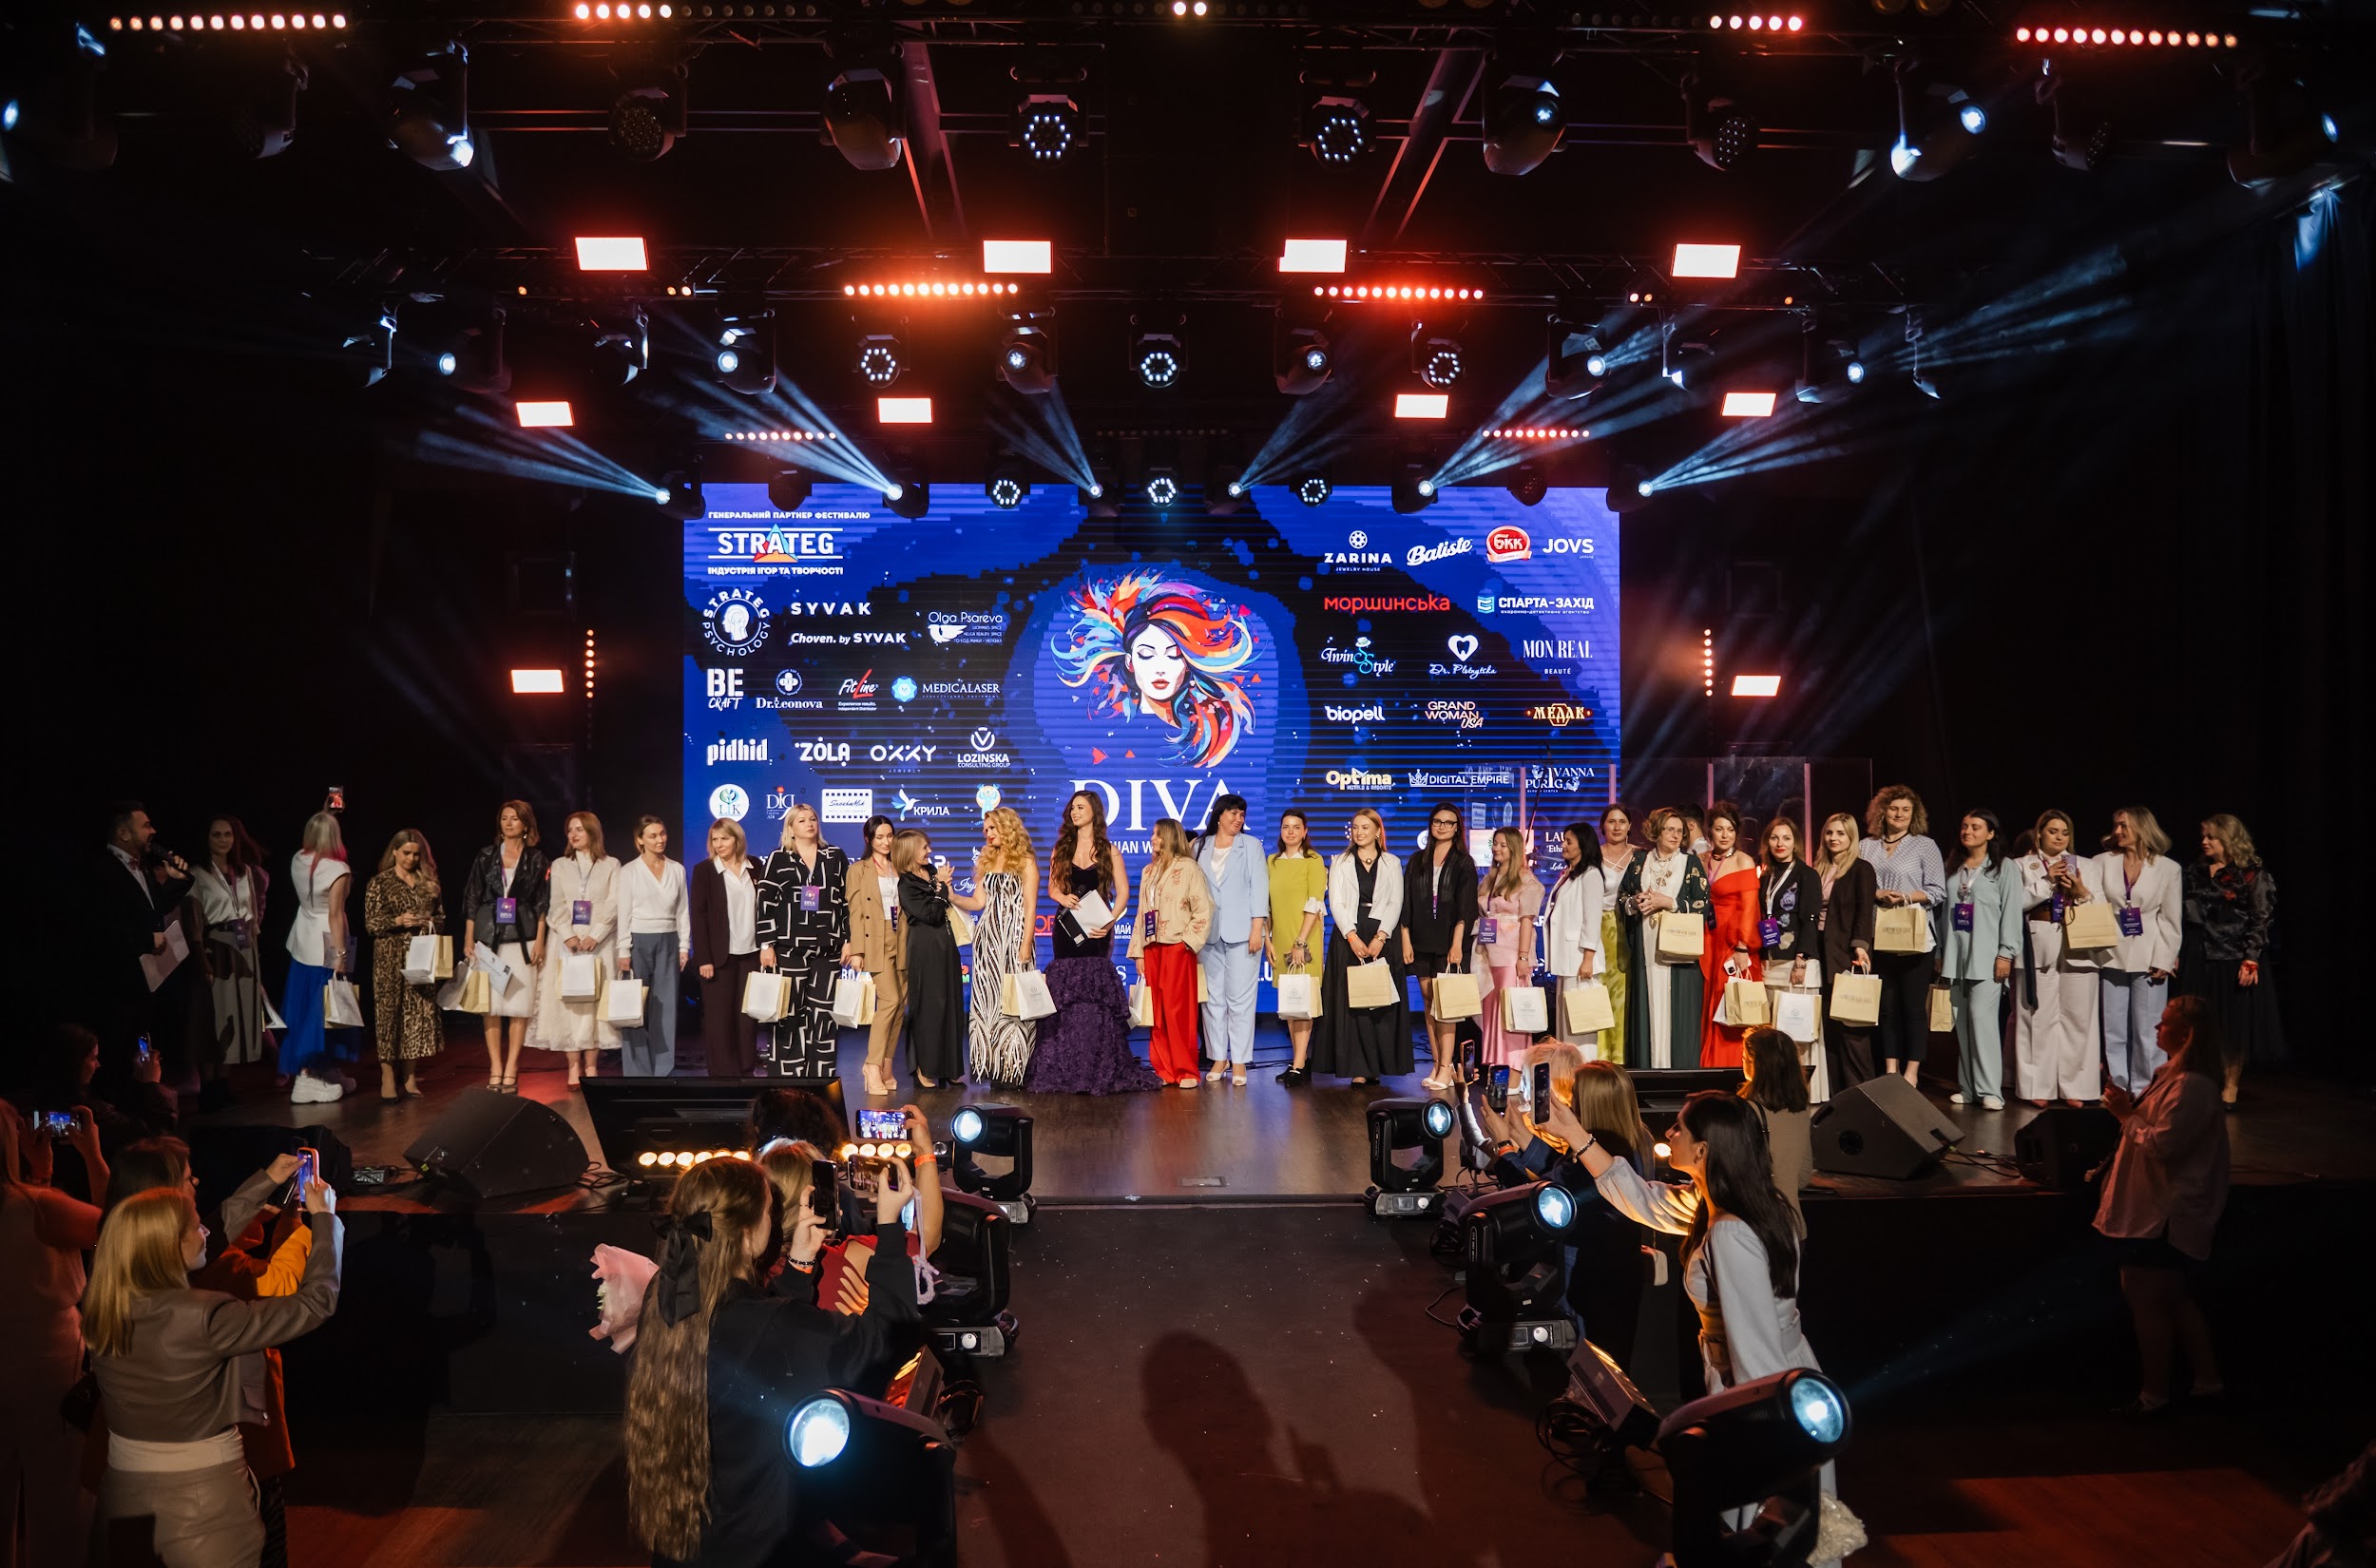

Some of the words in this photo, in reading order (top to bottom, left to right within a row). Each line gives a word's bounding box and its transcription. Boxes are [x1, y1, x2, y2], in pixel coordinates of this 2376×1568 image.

[708, 510, 771, 520] ГЕНЕРАЛЬНИЙ
[773, 511, 813, 520] ПАРТНЕР
[814, 511, 871, 520] ФЕСТИВАЛЮ
[718, 531, 834, 555] STRATEG
[1542, 538, 1595, 554] JOVS
[1324, 552, 1392, 564] ZARINA
[1407, 536, 1472, 567] Batiste
[707, 566, 757, 576] ІНДУСТРІЯ
[757, 566, 778, 575] ІГОР
[792, 566, 844, 575] ТВОРЧОСТІ
[702, 588, 770, 619] STRATEG
[790, 602, 872, 616] SYVAK
[1498, 597, 1595, 610] СПАРТА-ЗАХІД
[929, 611, 957, 624] Olga
[961, 611, 1003, 623] Psareva
[702, 621, 771, 657] PSYCHOLOGY
[790, 632, 837, 644] Choven.
[838, 635, 851, 645] by
[853, 632, 907, 643] SYVAK
[1523, 640, 1554, 659] MON
[1558, 640, 1593, 659] REAL
[1428, 663, 1451, 675] Dr.
[707, 668, 744, 698] BE
[922, 683, 1000, 694] MEDICALASER
[708, 697, 743, 712] CRAFT
[1428, 701, 1476, 711] GRAND
[1324, 705, 1386, 724] biopell
[1425, 711, 1479, 721] WOMAN
[1532, 706, 1586, 723] МЕДАК
[1461, 717, 1484, 729] USA
[706, 738, 768, 766] pidhid
[870, 744, 937, 762] OXXY
[957, 754, 1009, 763] LOZINSKA
[1326, 767, 1392, 791] Optima
[1428, 774, 1468, 784] DIGITAL
[1470, 774, 1510, 784] EMPIRE
[913, 806, 950, 816] КРИЛА
